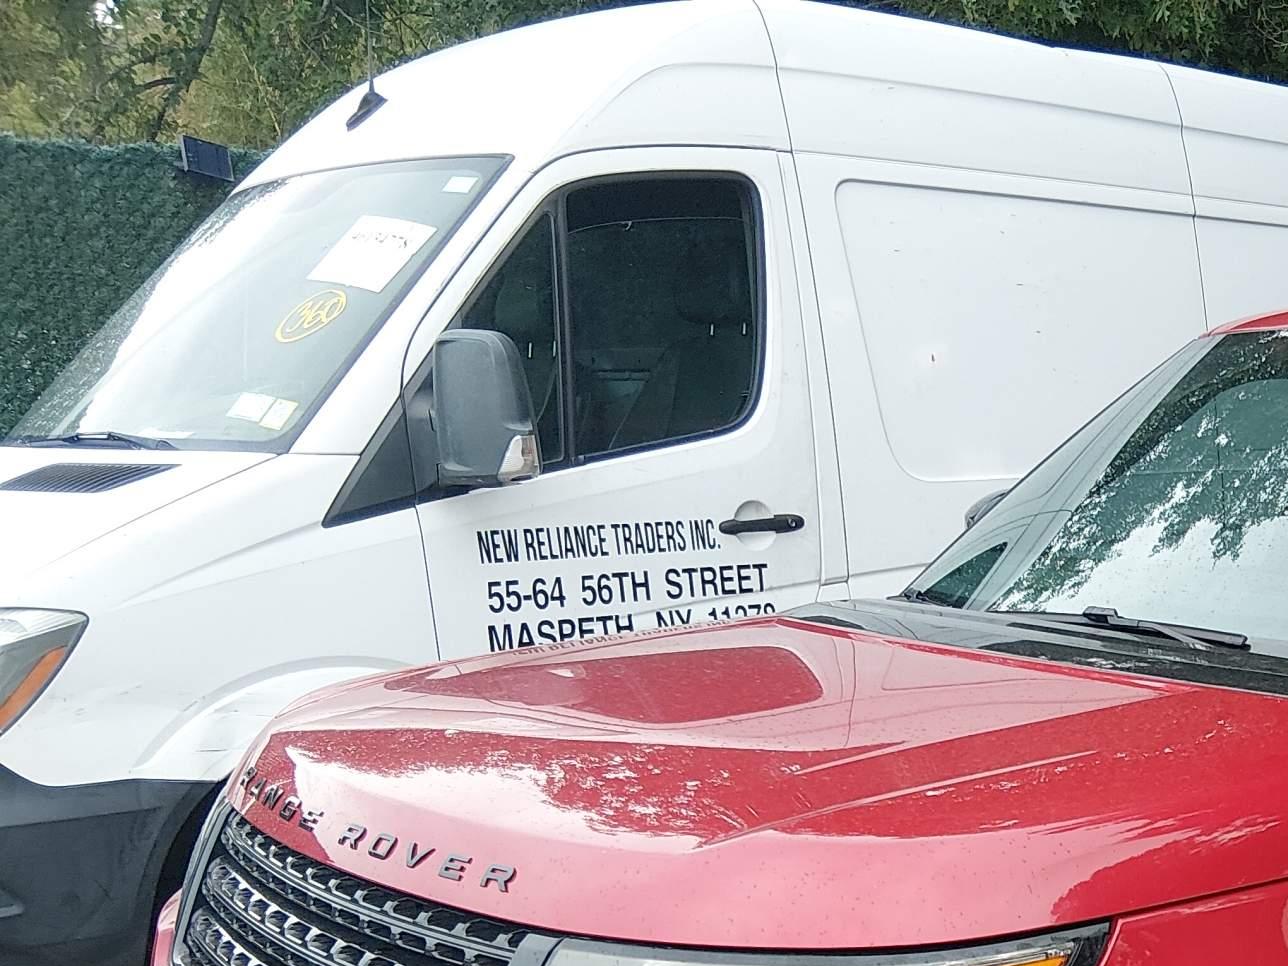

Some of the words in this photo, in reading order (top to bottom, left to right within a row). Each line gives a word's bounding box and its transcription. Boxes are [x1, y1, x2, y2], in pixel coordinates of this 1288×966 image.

[476, 528, 520, 564] NEW
[525, 523, 608, 561] RELIANCE
[610, 519, 686, 556] TRADERS
[689, 518, 721, 551] INC.
[487, 576, 567, 613] 55-64
[581, 570, 652, 606] 56TH
[664, 563, 769, 600] STREET
[487, 613, 635, 653] MASPETH
[240, 766, 324, 832] RANGE
[338, 822, 518, 893] ROVER
